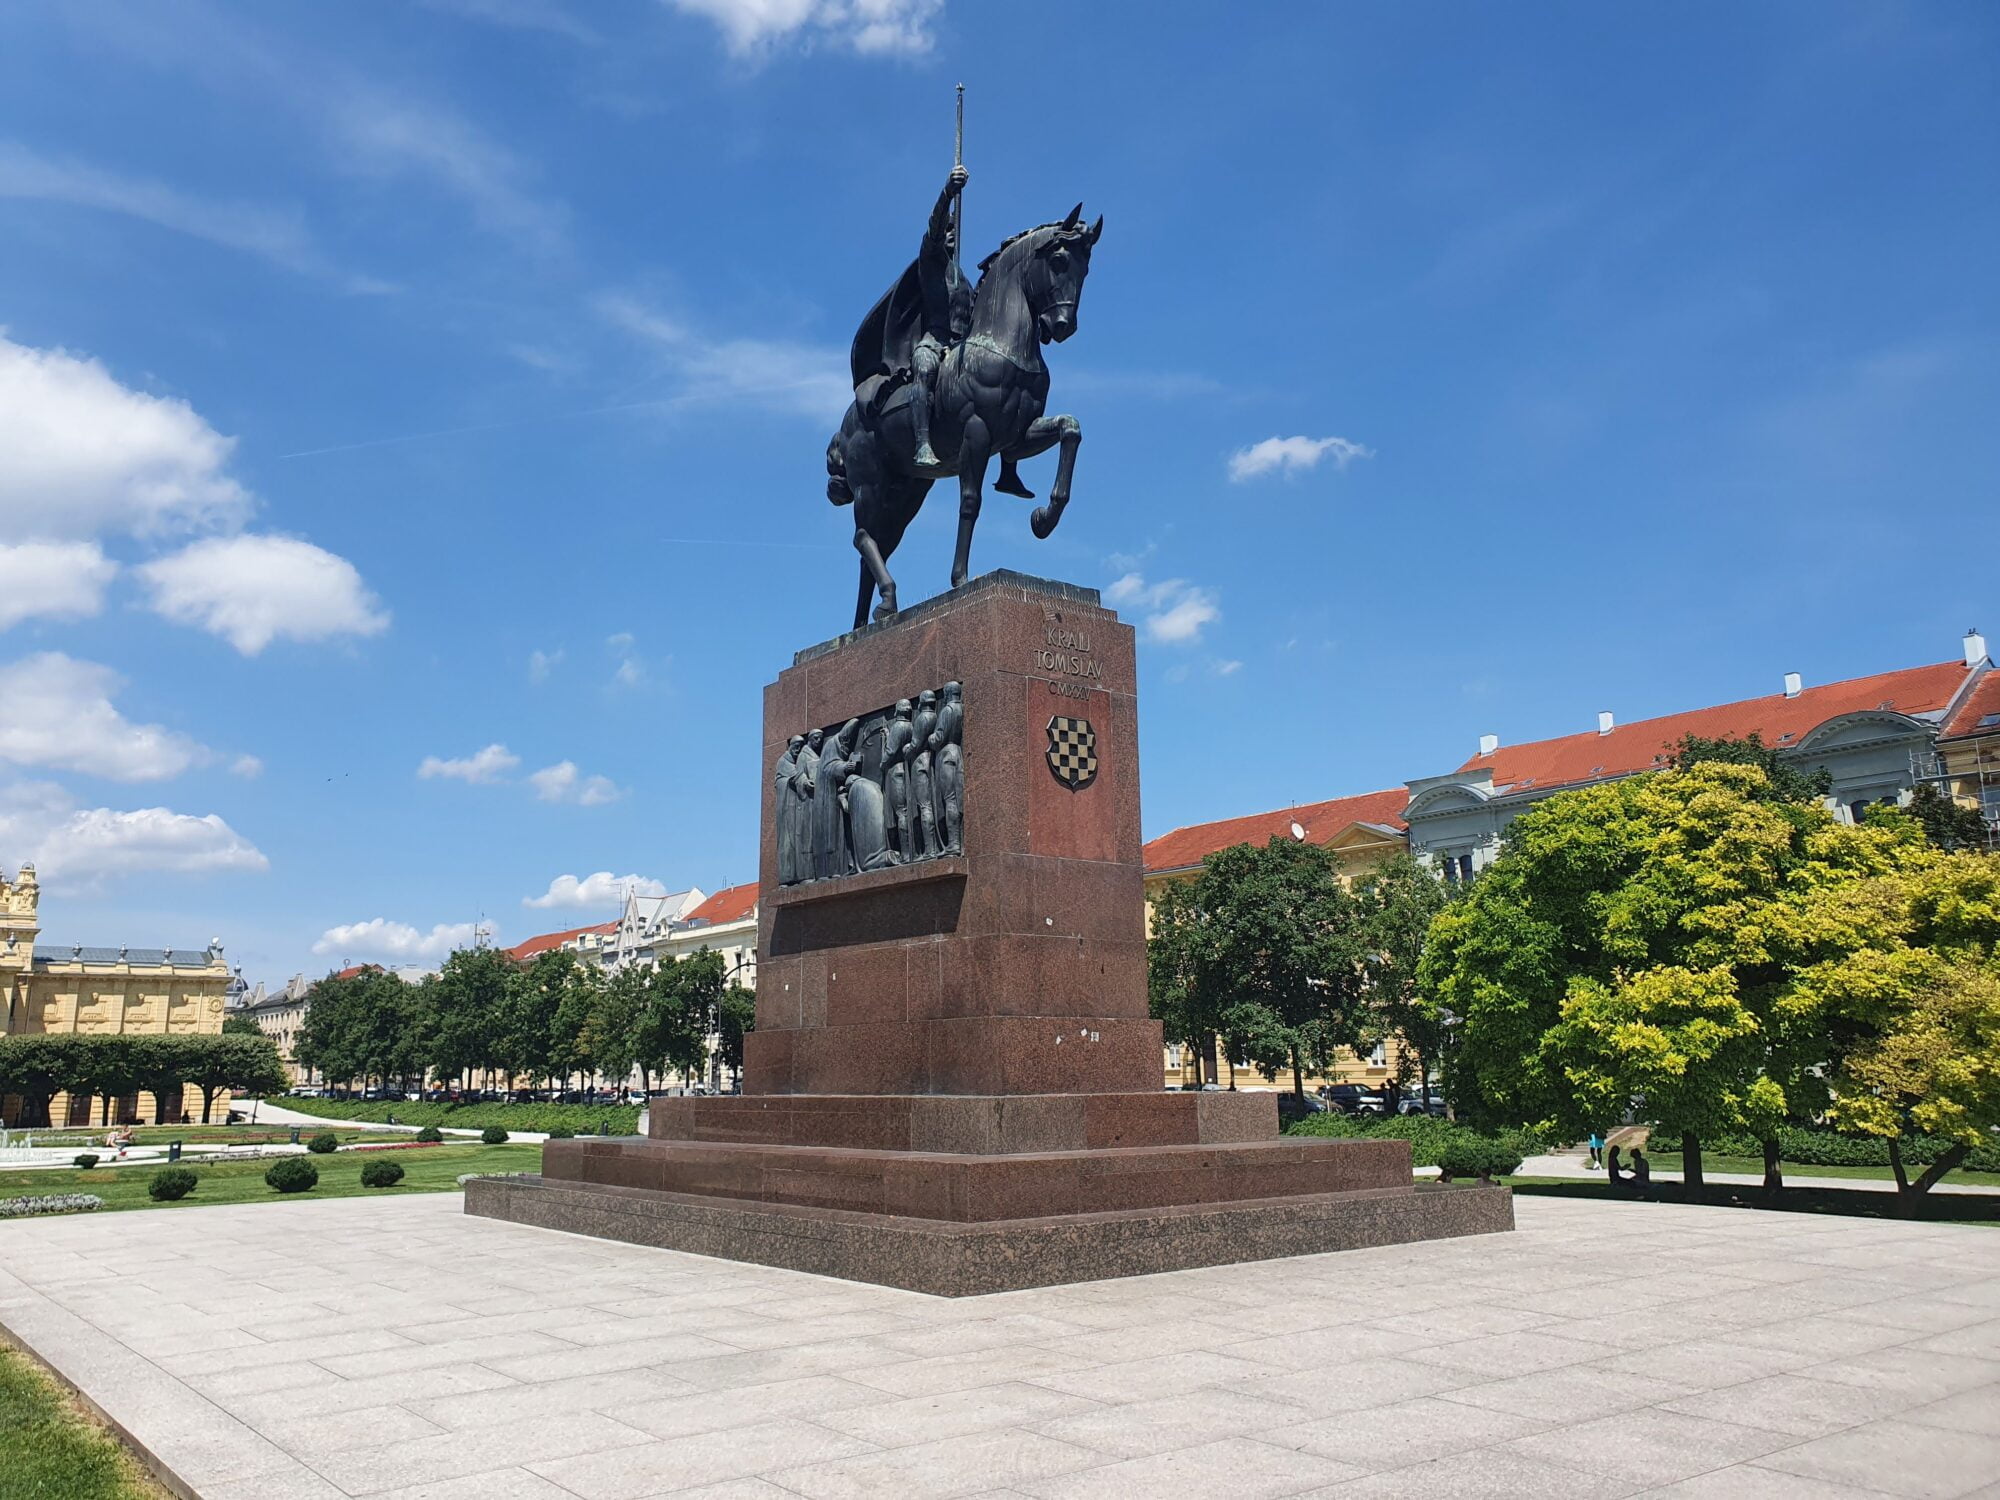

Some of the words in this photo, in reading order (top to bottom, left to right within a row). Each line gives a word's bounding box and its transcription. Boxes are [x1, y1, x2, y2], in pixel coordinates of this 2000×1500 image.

[1047, 627, 1090, 653] KRALJ
[1034, 649, 1103, 680] TOMISLAV
[1048, 681, 1091, 701] CMXXV
